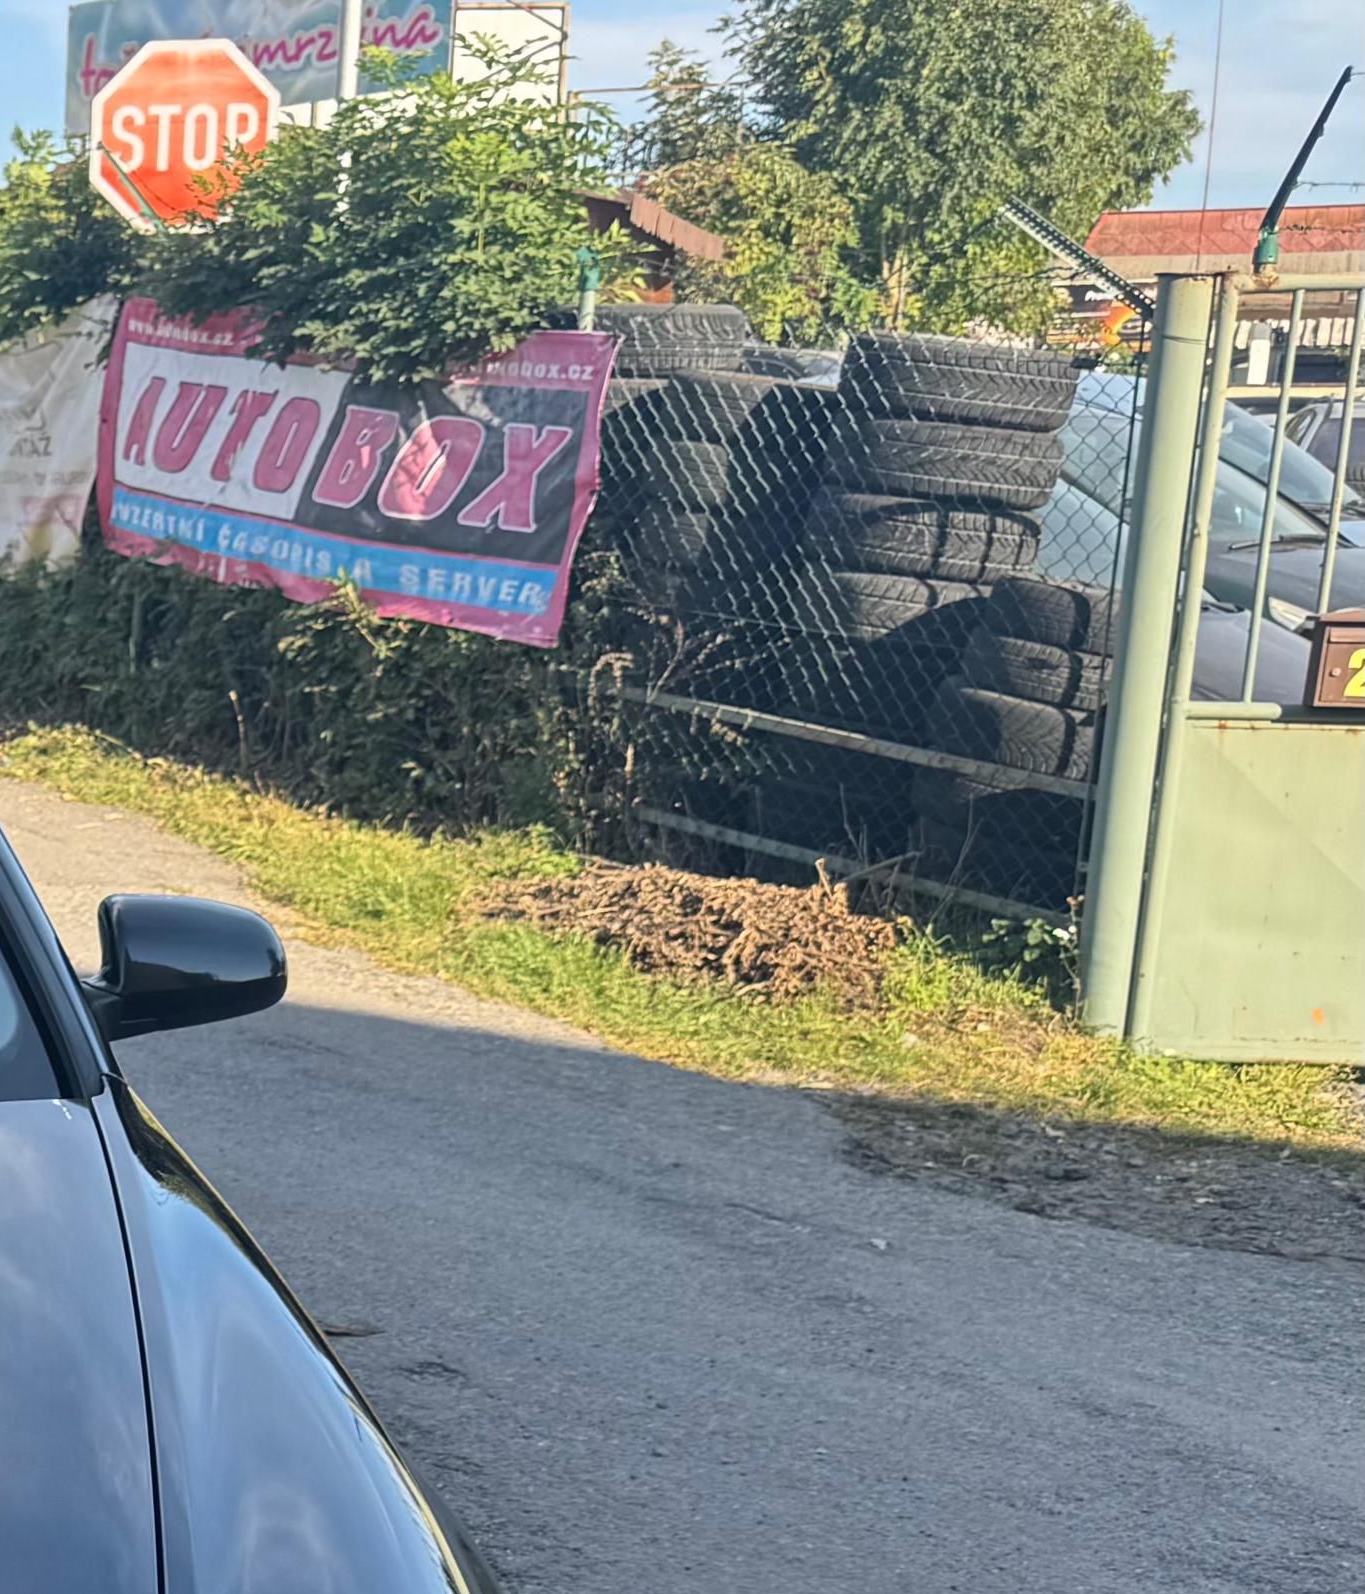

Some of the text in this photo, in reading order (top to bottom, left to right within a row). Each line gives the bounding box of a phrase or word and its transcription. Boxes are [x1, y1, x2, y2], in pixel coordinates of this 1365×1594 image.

[112, 102, 259, 173] STOP
[122, 377, 573, 533] AUTOBOX
[399, 564, 549, 611] SERVER
